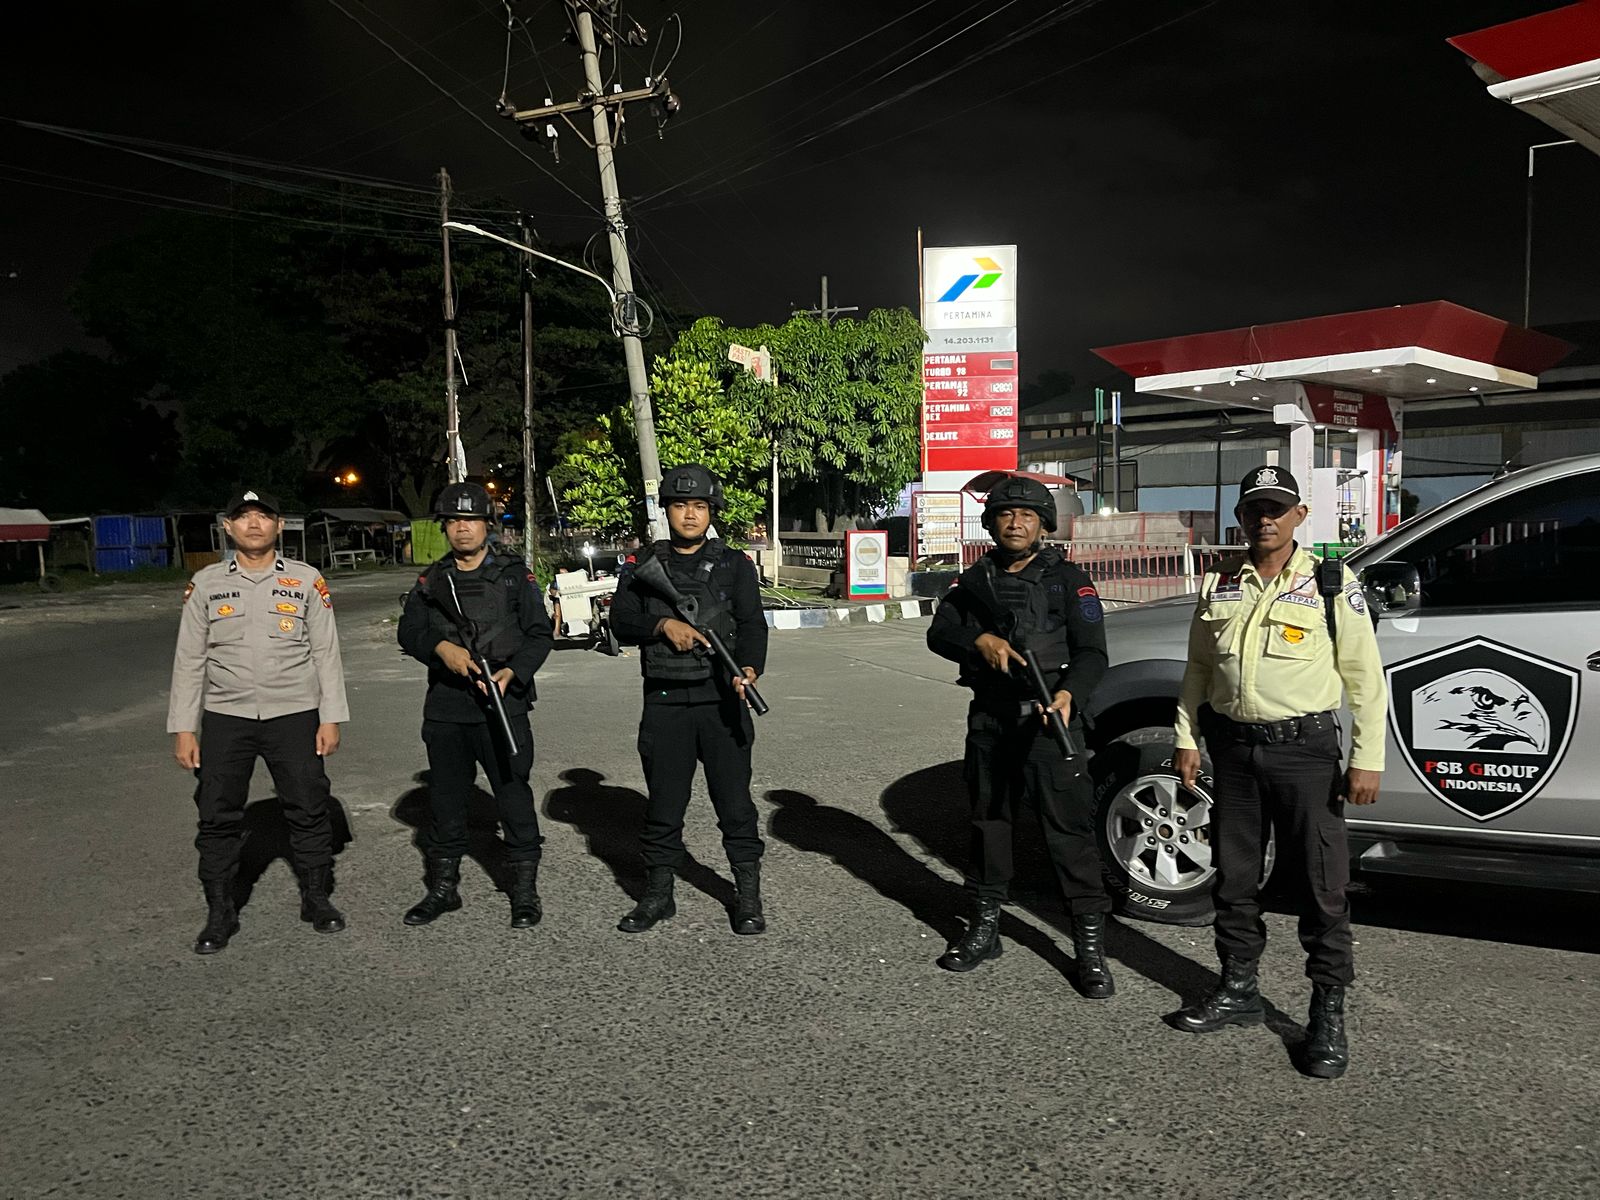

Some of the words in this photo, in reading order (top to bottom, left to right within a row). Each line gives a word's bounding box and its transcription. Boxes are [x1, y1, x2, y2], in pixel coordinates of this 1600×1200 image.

[943, 311, 992, 320] PERTAMINA
[944, 337, 994, 345] 14.203.1131
[925, 355, 967, 365] PERTAMAX
[925, 367, 952, 376] TURBO
[956, 367, 966, 376] 98
[925, 381, 968, 390] PERTAMAX
[957, 389, 968, 397] 92
[925, 404, 970, 413] PERTAMINA
[925, 432, 958, 441] DEXLITE
[272, 589, 304, 600] POLRI
[1280, 593, 1318, 606] SATPAM
[1425, 761, 1463, 775] PSB
[1468, 763, 1539, 779] GROUP
[1440, 779, 1523, 793] INDONESIA
